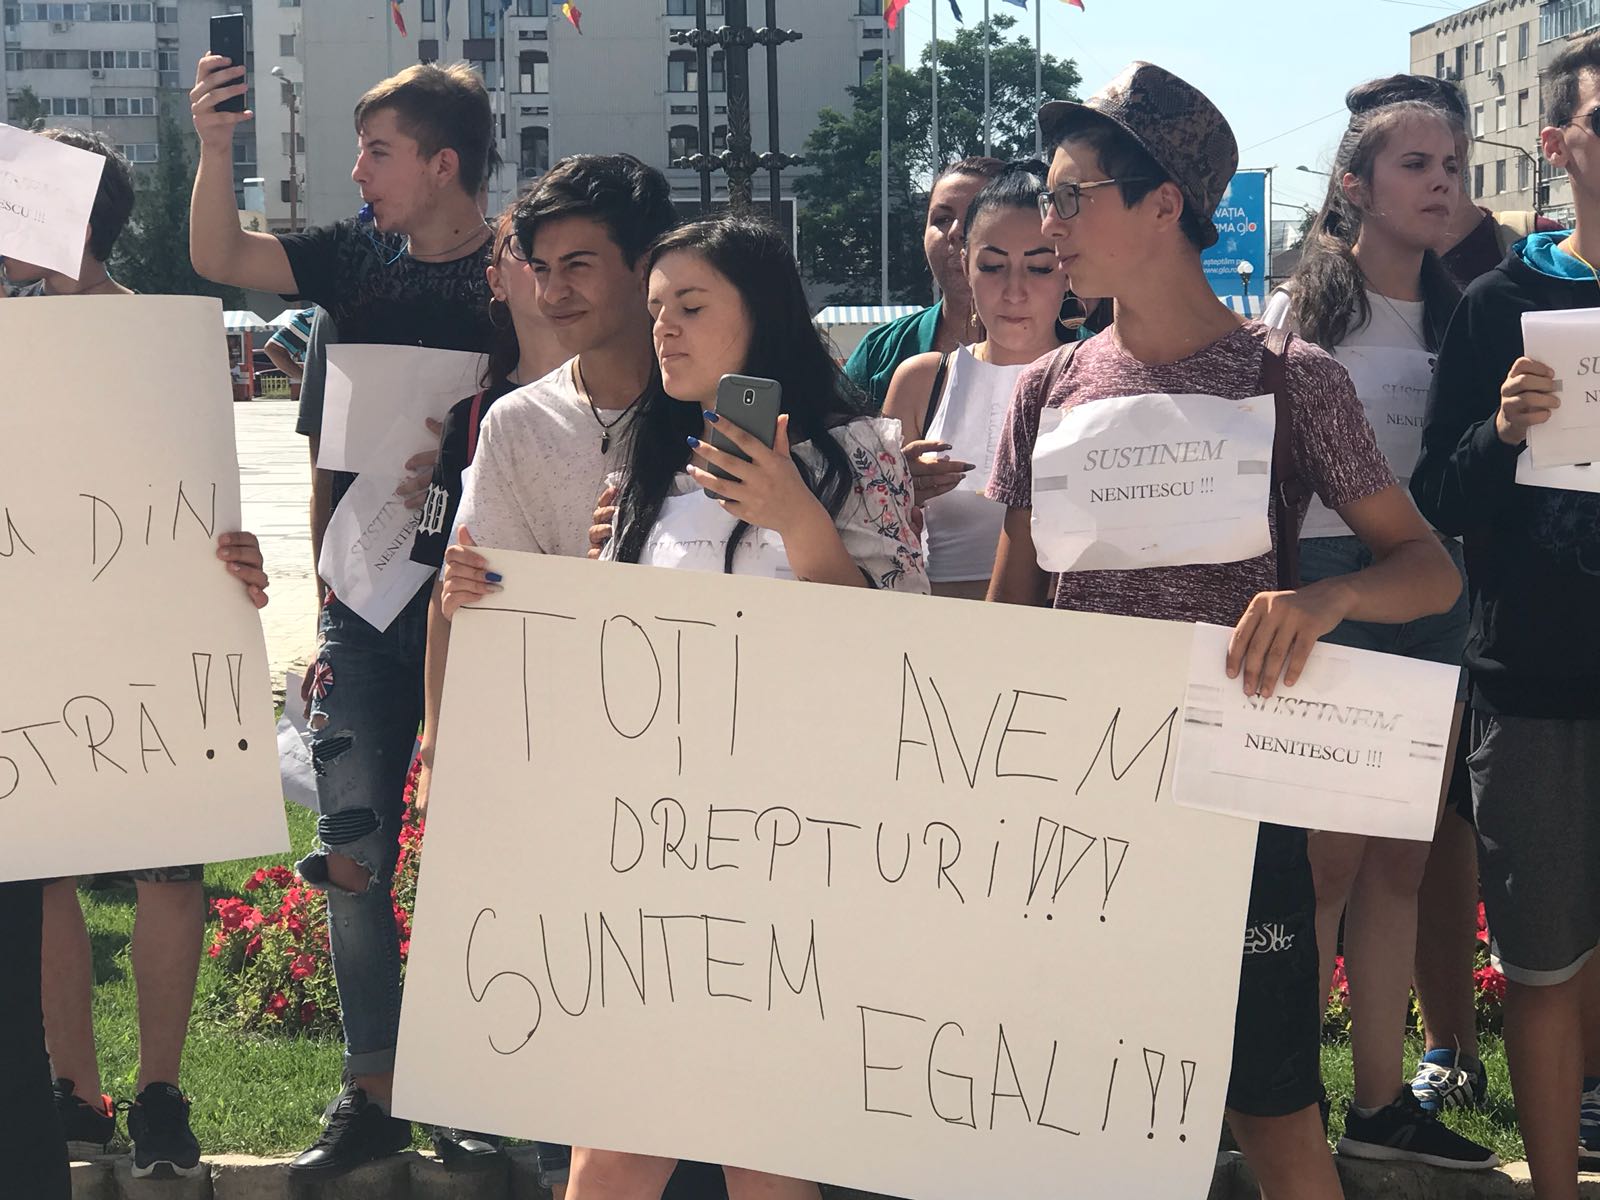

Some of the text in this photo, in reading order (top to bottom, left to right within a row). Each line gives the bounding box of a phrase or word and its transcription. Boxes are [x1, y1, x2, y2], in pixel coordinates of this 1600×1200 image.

[1236, 216, 1257, 236] glo
[1083, 439, 1228, 472] SUSTINEM
[1090, 477, 1214, 503] NENITESCU !!!
[896, 652, 1178, 802] AVEM
[1244, 733, 1383, 768] NENITESCU !!!
[466, 907, 825, 1055] SUNTEM
